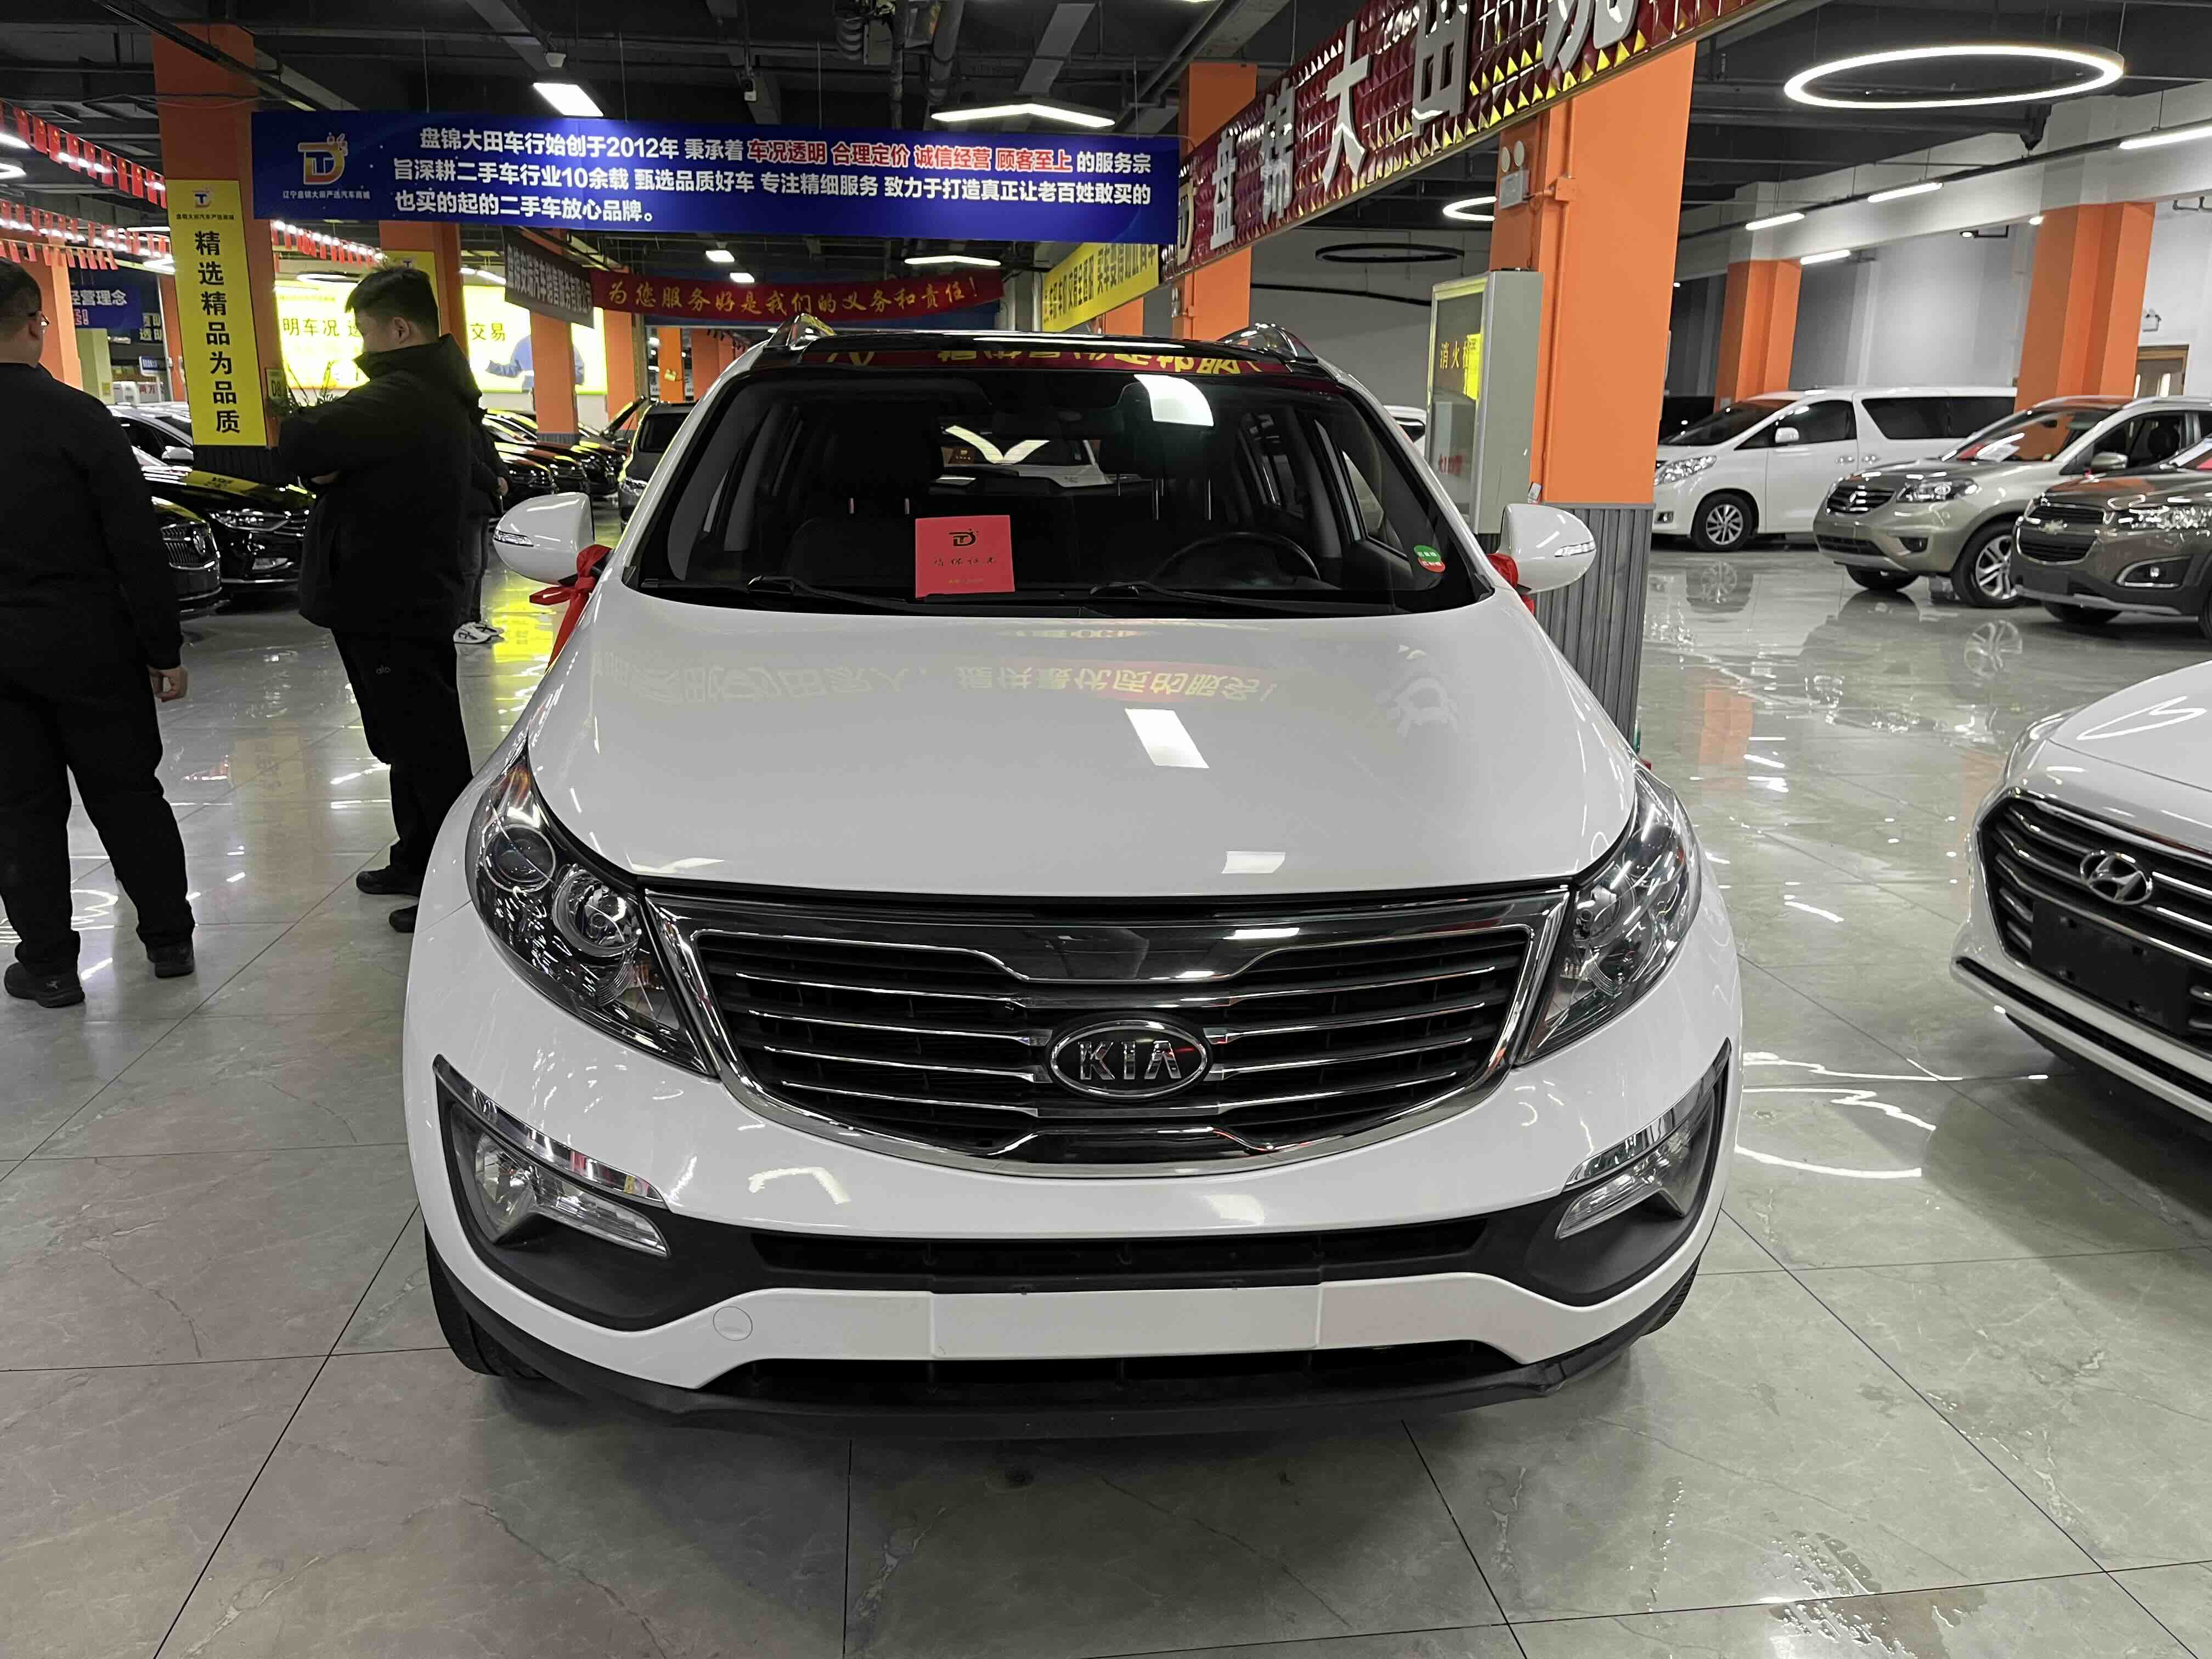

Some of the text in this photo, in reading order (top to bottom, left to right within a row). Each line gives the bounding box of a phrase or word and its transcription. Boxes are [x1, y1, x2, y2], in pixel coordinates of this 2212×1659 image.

[1211, 0, 1638, 250] 盘锦大田
[420, 127, 1152, 175] 盘锦大田车行始创于2012年 秉承着 车况透明 合理定价 诚信经营 顾客至上 的服务宗
[394, 157, 1152, 205] 旨深耕二手车行业10余载 甄选品质好车 专注精细服务 致力于打造真正让老百姓敢买的
[395, 191, 655, 223] 也买的起的二手车放心品牌。
[194, 230, 241, 433] 精选精品为品质
[471, 323, 506, 342] 交易
[1077, 1040, 1182, 1080] KIA
